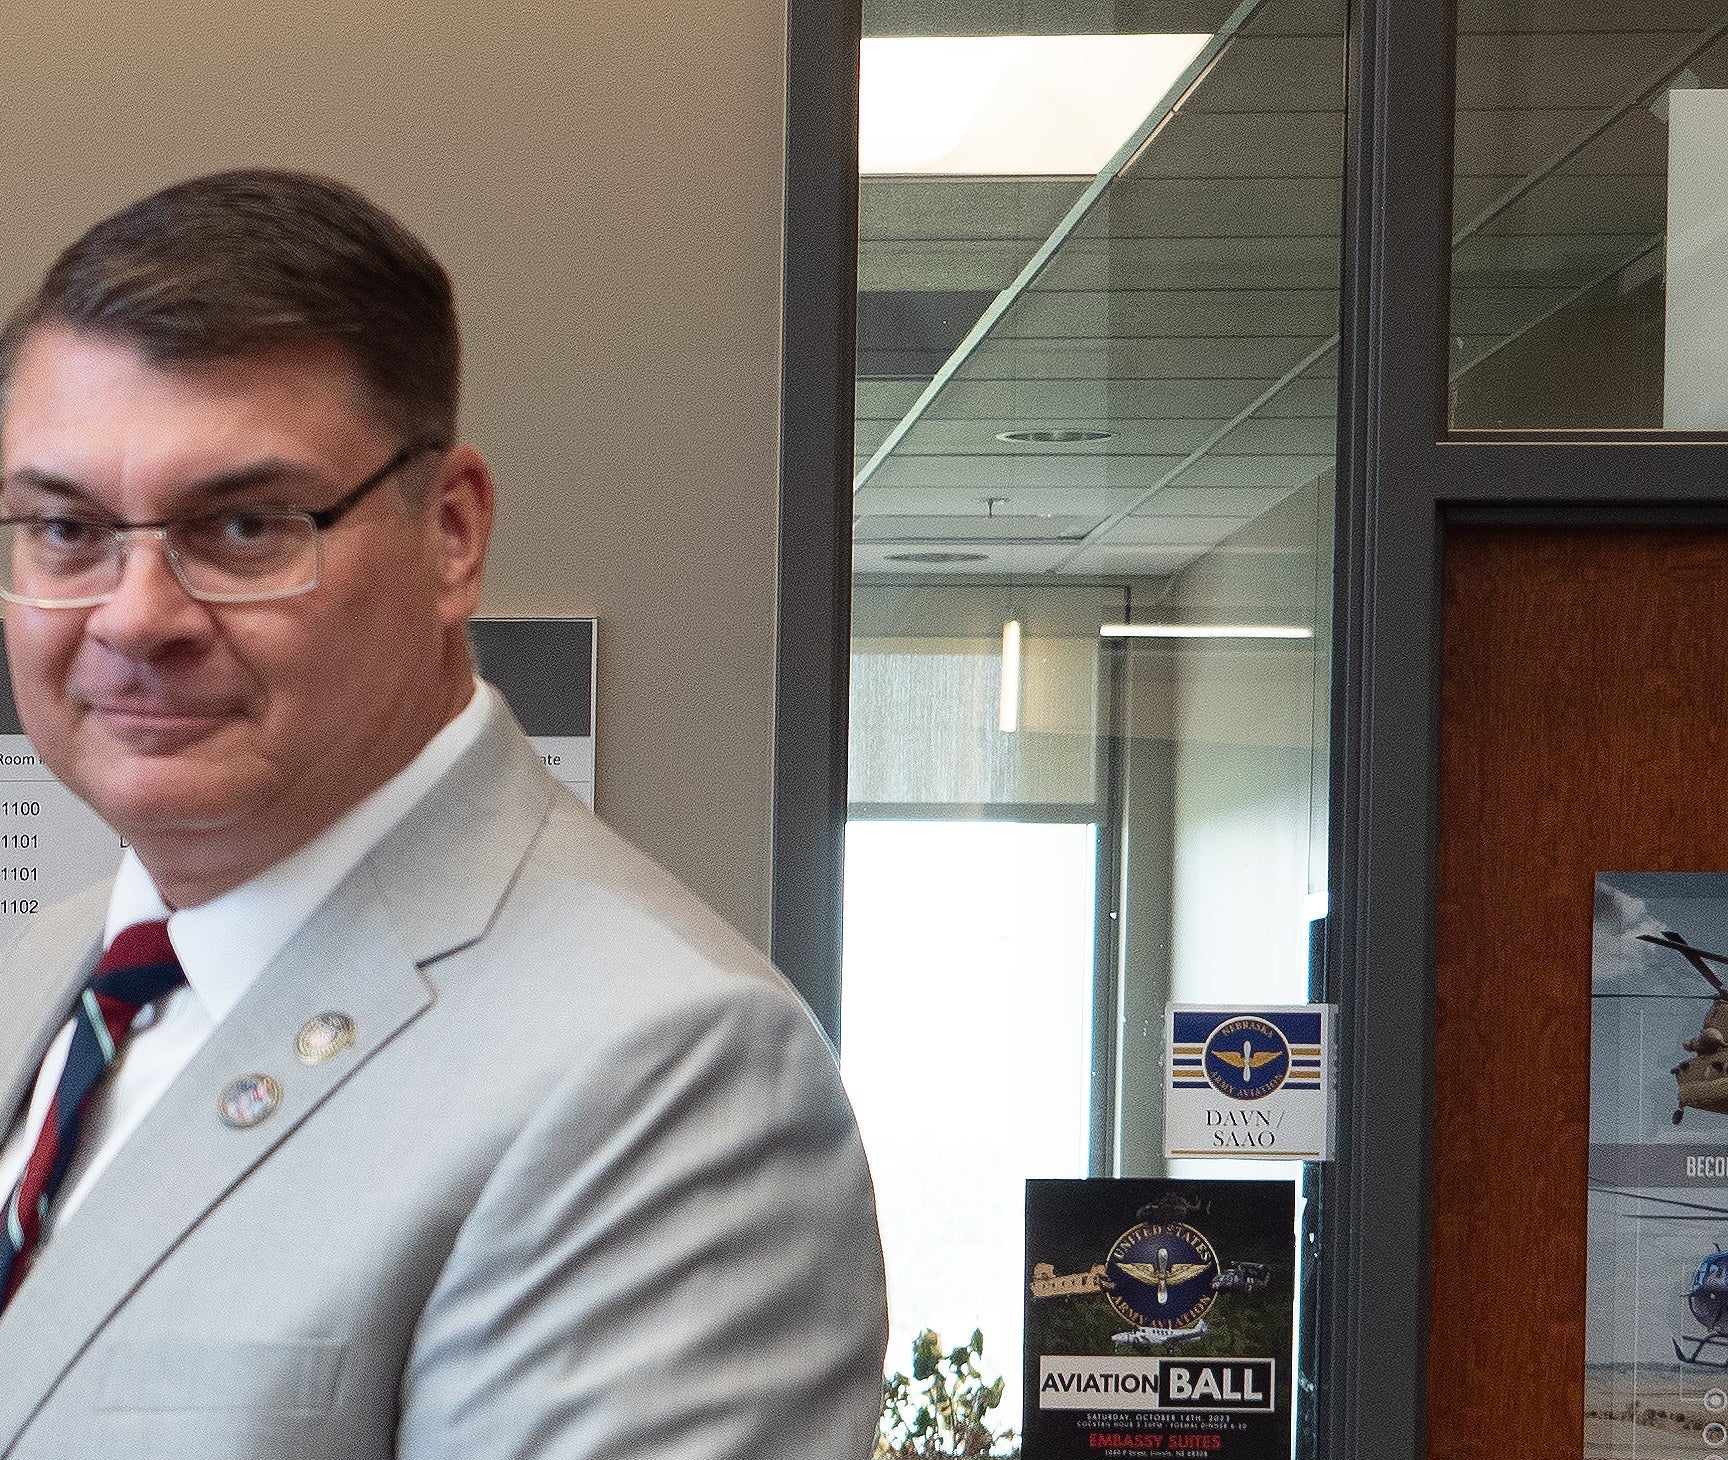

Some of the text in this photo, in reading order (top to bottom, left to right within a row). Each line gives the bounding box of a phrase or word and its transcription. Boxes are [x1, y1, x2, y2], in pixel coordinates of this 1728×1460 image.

[1, 802, 40, 816] 1100
[1, 834, 38, 849] 1101
[1, 867, 38, 881] 1101
[0, 900, 39, 914] 1102
[1221, 1020, 1273, 1038] NEBRASKA
[1206, 1110, 1271, 1127] DAVN
[1213, 1130, 1275, 1148] SAAO
[1686, 1156, 1728, 1177] BECO
[1113, 1224, 1211, 1261] UNITED STATES
[1041, 1367, 1263, 1401] AVIATION BALL
[1089, 1433, 1222, 1450] EMBASSY SUITES
